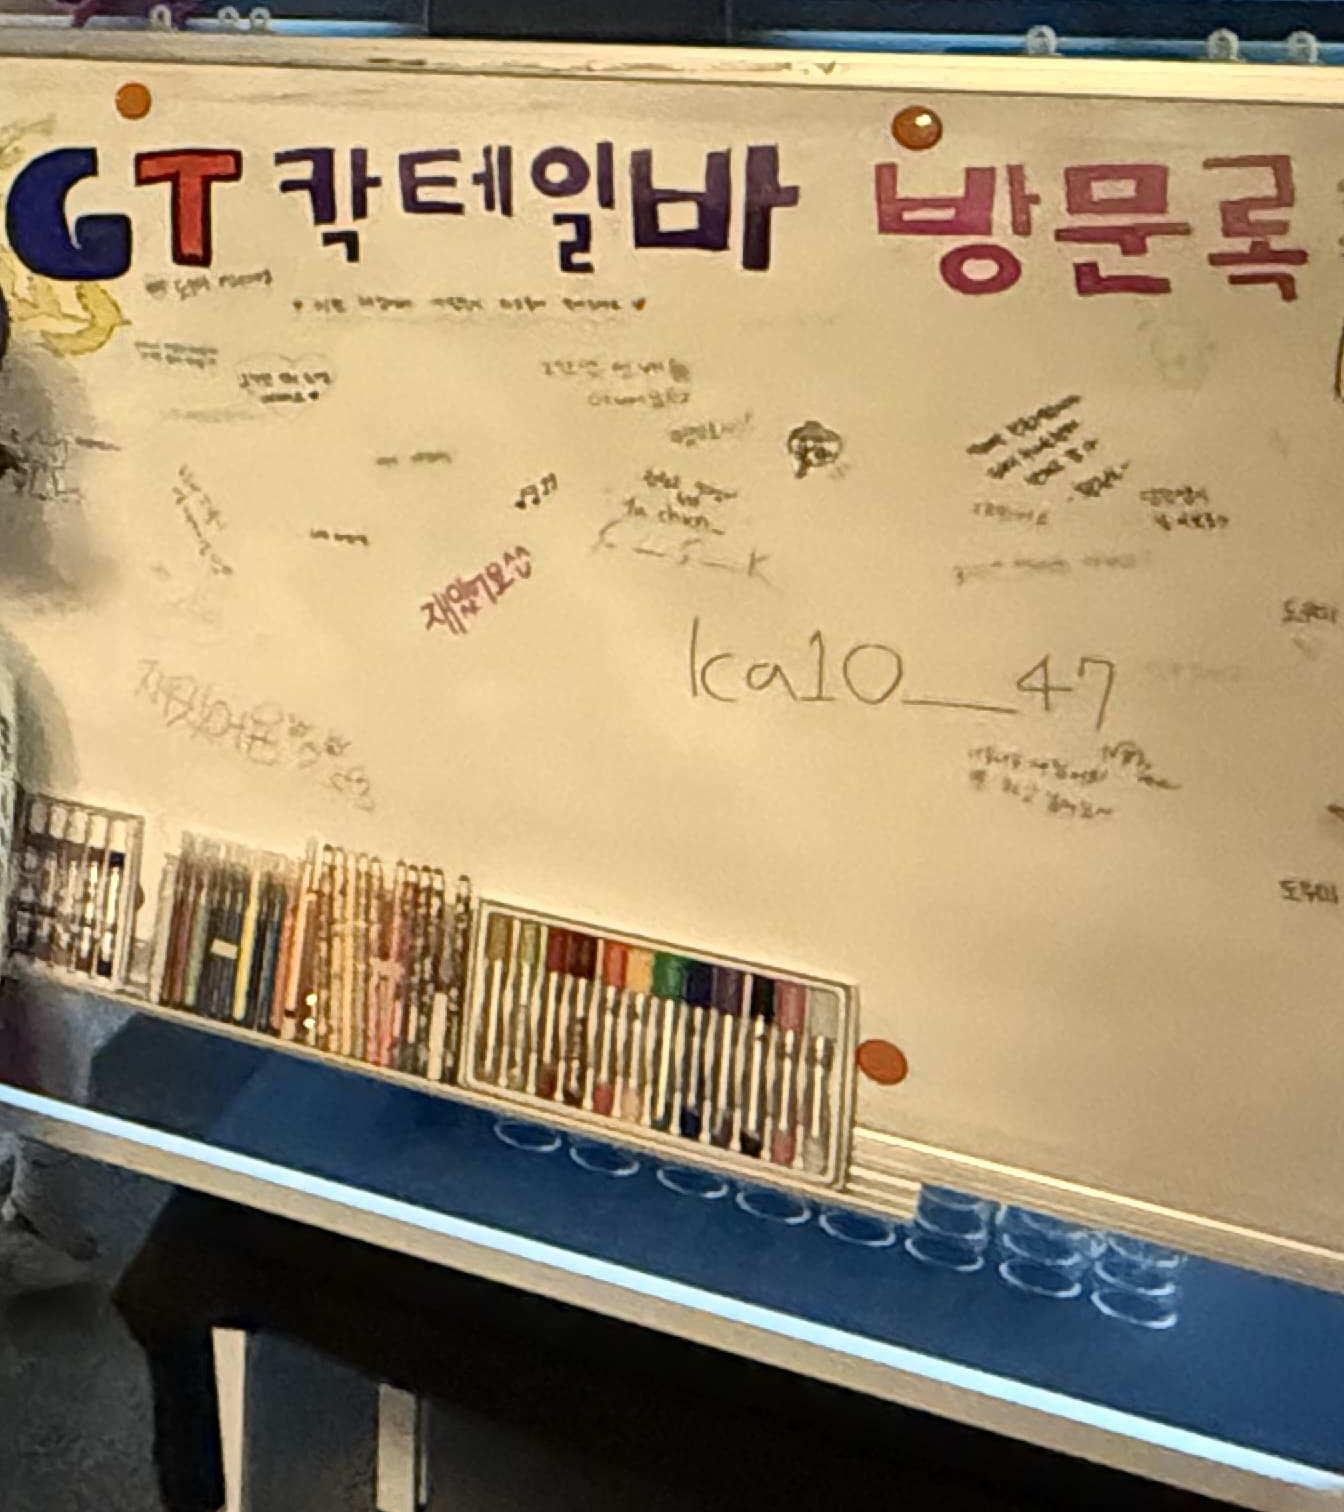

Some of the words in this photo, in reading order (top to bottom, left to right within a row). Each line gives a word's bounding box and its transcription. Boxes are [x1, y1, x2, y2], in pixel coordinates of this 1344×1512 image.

[5, 147, 243, 281] GT
[274, 141, 799, 273] 칵테일바
[874, 155, 1309, 302] 방문록
